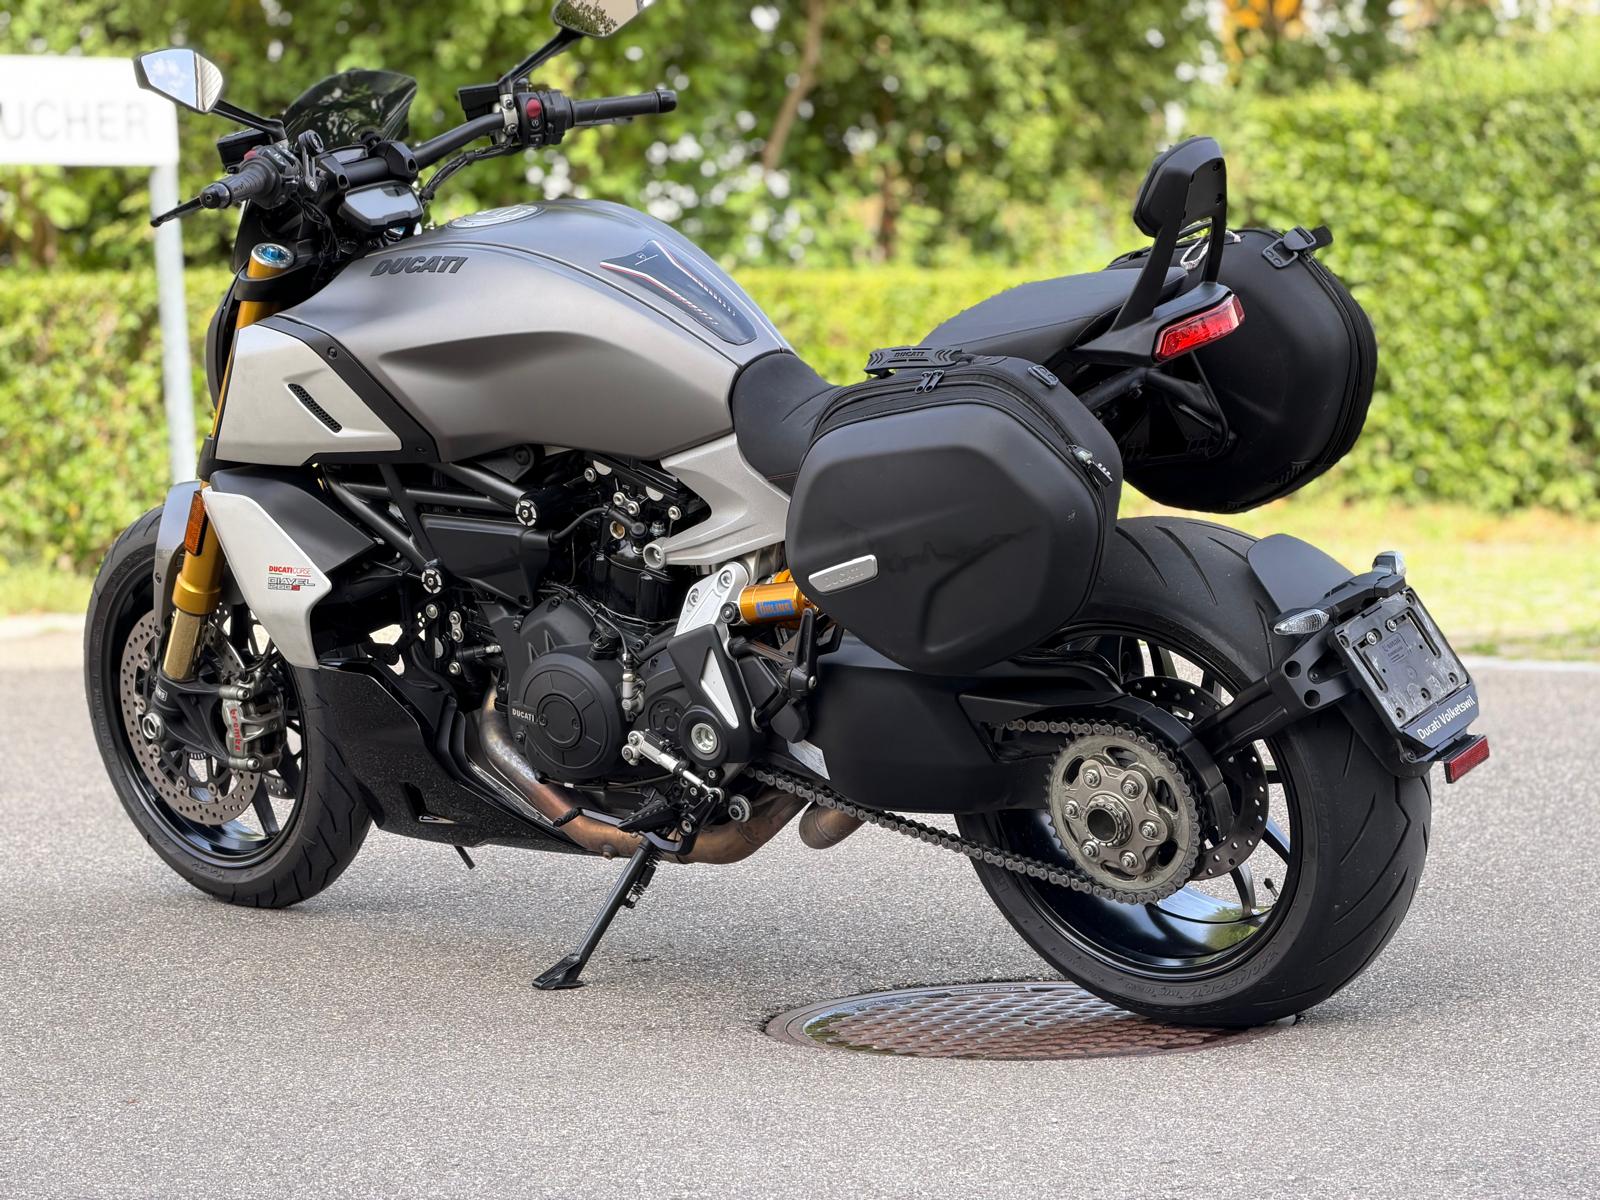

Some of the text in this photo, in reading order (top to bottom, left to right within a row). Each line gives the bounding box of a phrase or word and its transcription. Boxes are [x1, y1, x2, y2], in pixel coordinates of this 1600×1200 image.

[370, 255, 469, 277] DUCATI
[267, 576, 316, 587] DIAVEL
[511, 707, 536, 723] DUCATI
[1416, 694, 1476, 740] Ducati Volketswil
[230, 708, 241, 752] brembo
